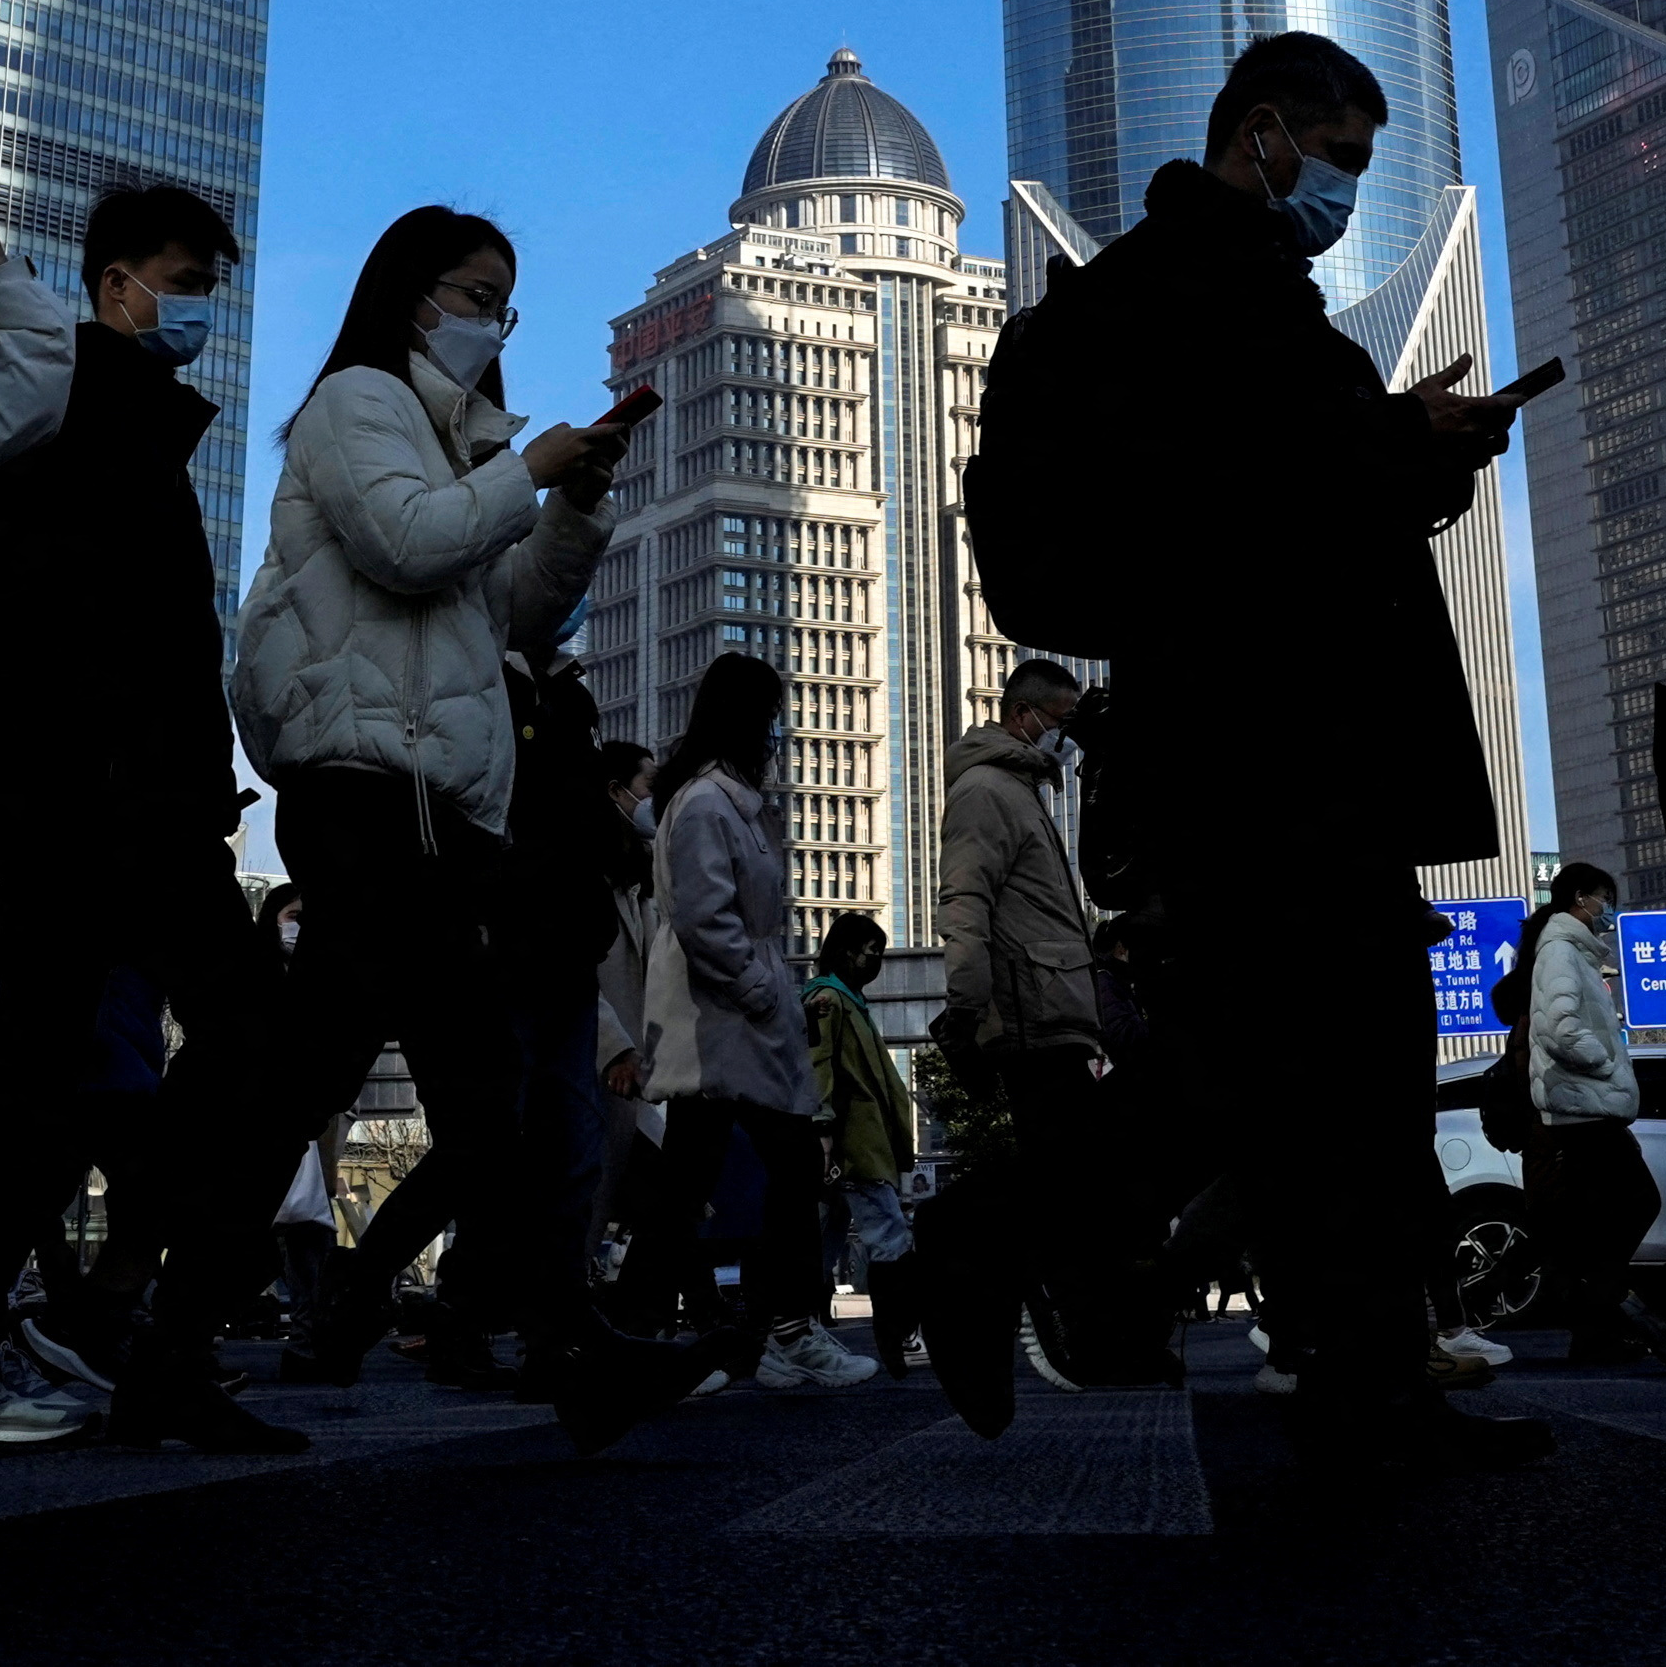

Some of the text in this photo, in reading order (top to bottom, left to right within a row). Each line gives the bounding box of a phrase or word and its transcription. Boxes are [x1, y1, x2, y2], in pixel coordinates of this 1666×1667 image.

[614, 294, 713, 371] 中国平安
[1459, 934, 1476, 946] Rd.
[1429, 949, 1482, 972] 道地道
[1432, 973, 1480, 987] e. Tunnel
[1434, 988, 1484, 1011] 隧道方向
[1440, 1013, 1483, 1026] (E) Tunnel
